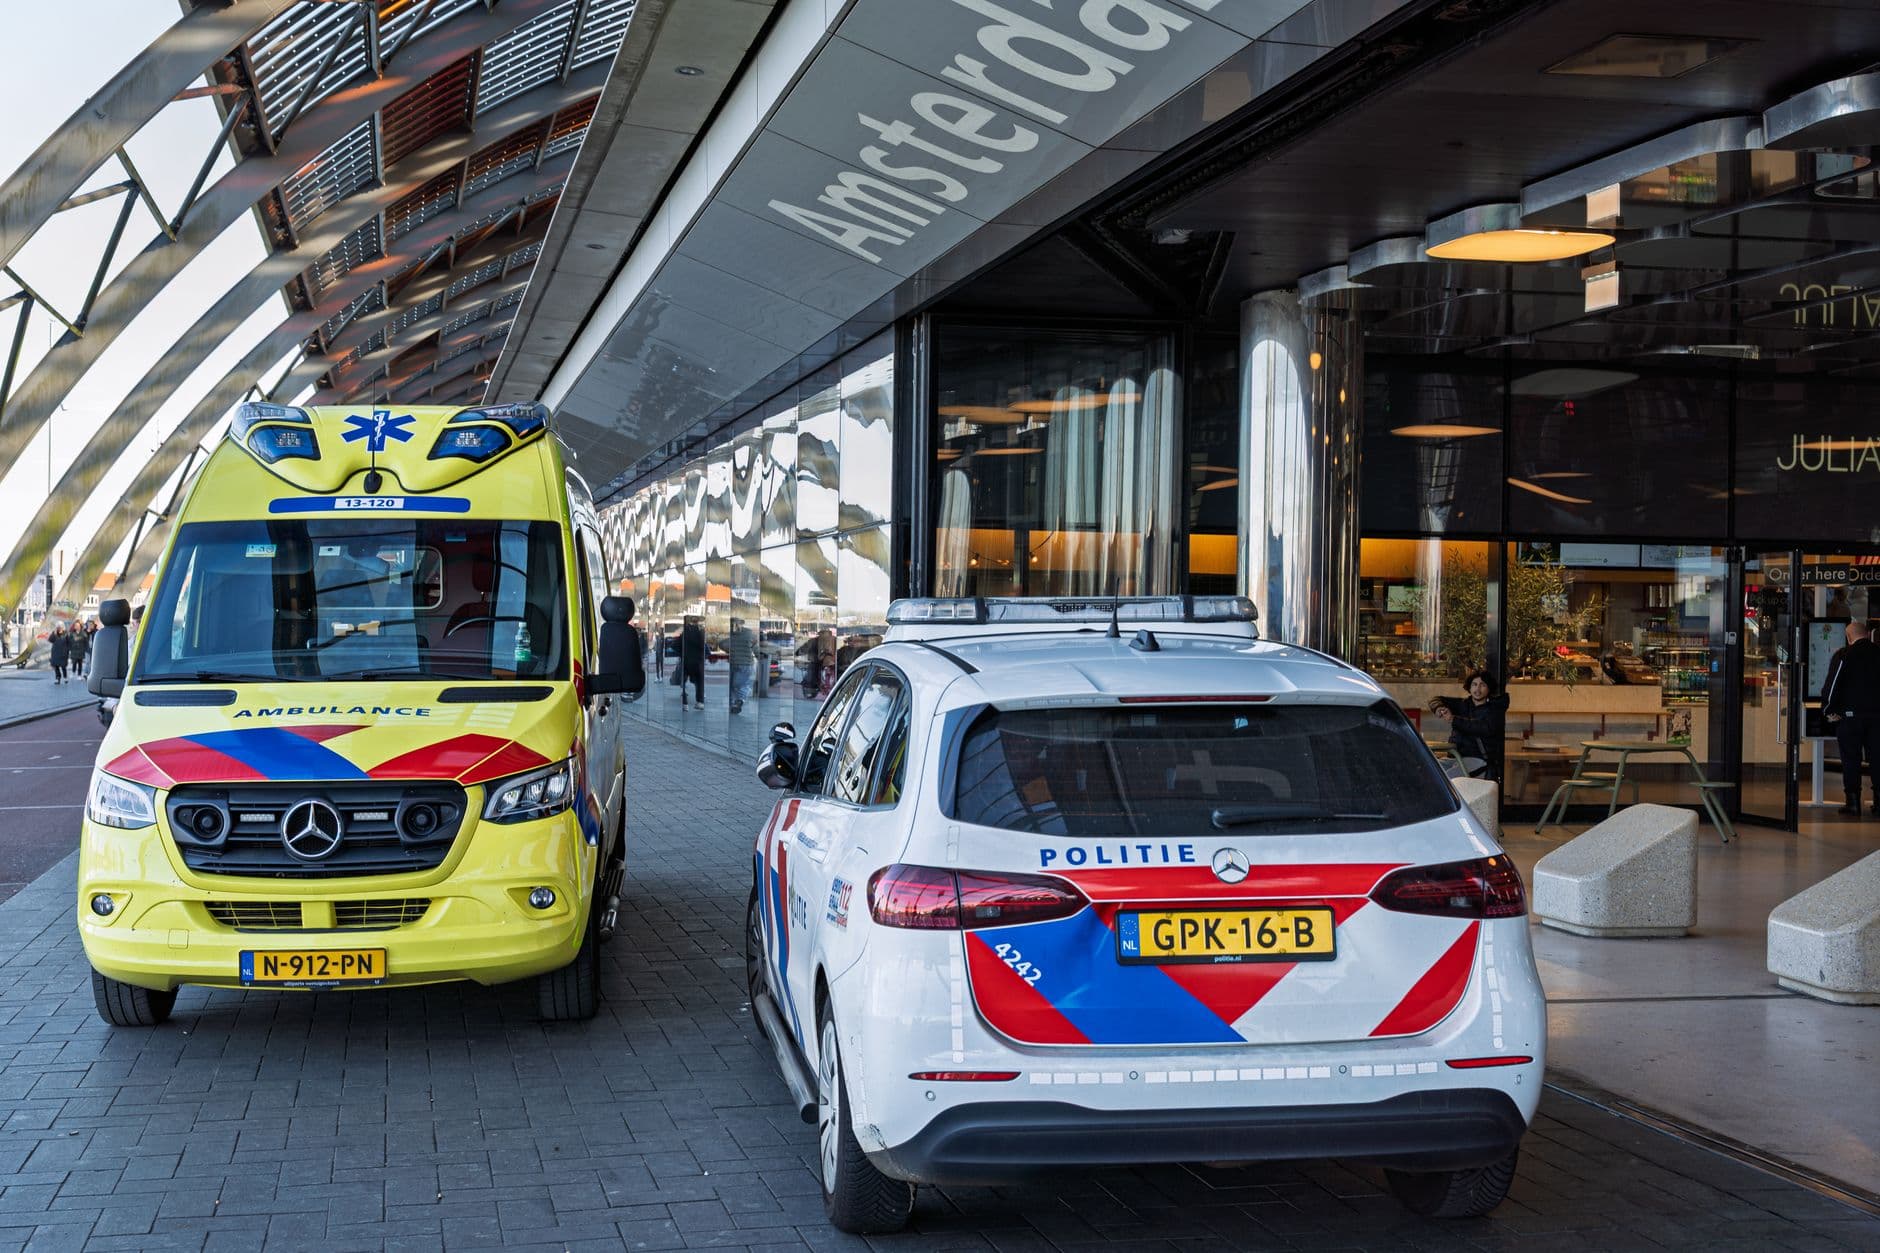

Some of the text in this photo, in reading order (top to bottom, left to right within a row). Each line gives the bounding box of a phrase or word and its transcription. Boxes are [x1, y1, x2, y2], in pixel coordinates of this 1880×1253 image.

[768, 0, 1223, 264] Amsterda
[344, 499, 395, 508] 13-120
[1815, 565, 1846, 580] here
[233, 706, 431, 719] AMBULANCE
[1039, 844, 1196, 867] POLITIE
[839, 882, 852, 912] 112
[1123, 915, 1315, 952] NL GPK-16-B
[242, 953, 373, 977] NL N-912-PN
[994, 943, 1042, 987] 4242
